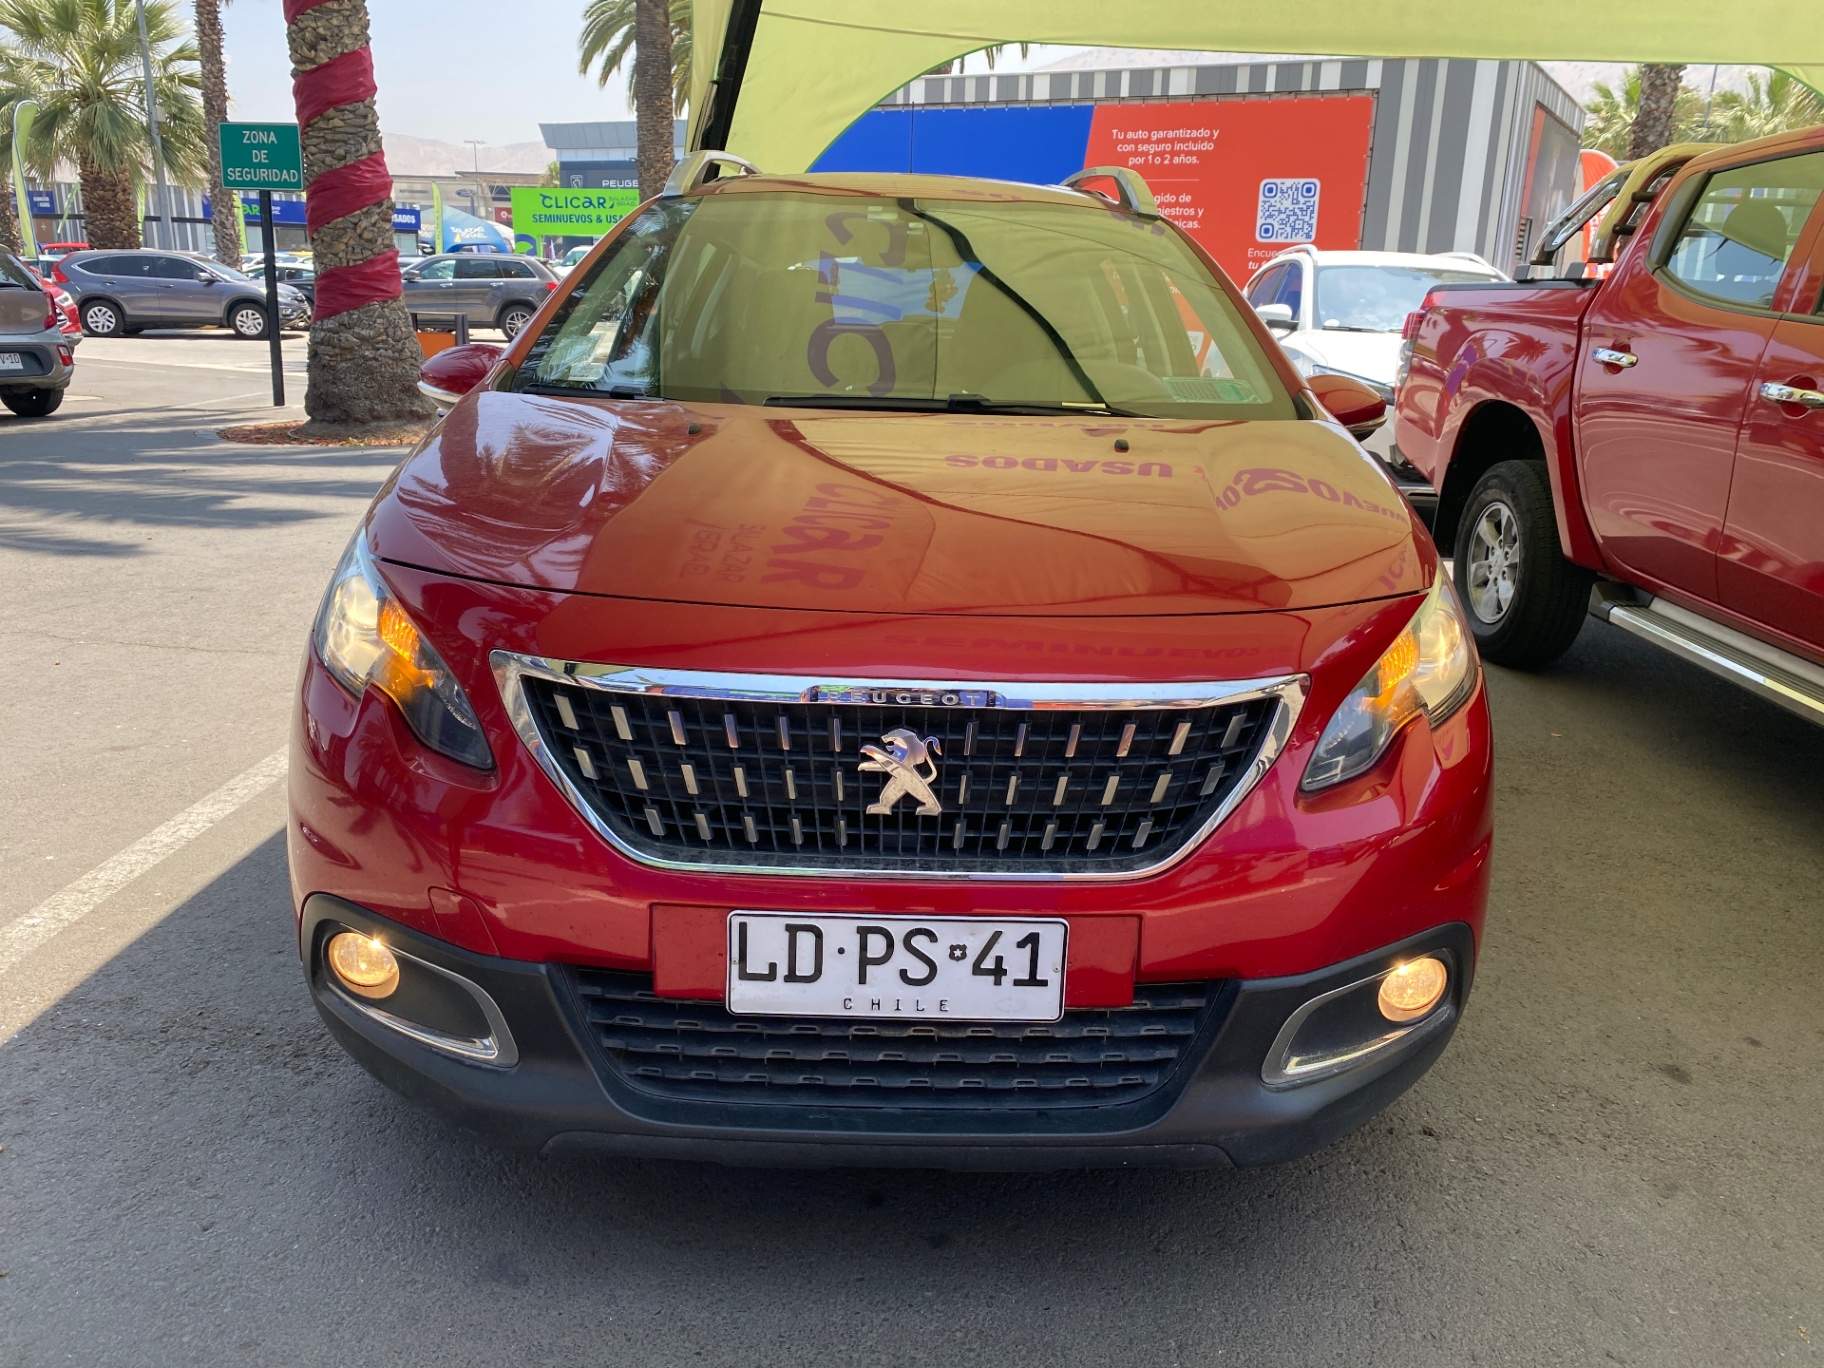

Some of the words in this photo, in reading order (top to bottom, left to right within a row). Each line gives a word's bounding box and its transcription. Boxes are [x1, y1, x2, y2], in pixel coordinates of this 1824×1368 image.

[242, 130, 278, 144] ZONA
[1111, 129, 1124, 139] Tu
[1126, 130, 1149, 139] auto
[1151, 128, 1210, 141] garantizado
[1213, 129, 1220, 139] y
[1117, 144, 1135, 152] con
[1137, 143, 1172, 153] seguro
[1174, 141, 1215, 151] incluido
[252, 149, 269, 163] DE
[1128, 156, 1146, 168] por
[1163, 154, 1171, 164] 2
[1173, 153, 1200, 164] años.
[227, 167, 298, 182] SEGURIDAD
[602, 179, 639, 187] PEUGE
[1154, 193, 1176, 205] gido
[1178, 193, 1192, 203] de
[532, 214, 593, 223] SEMINUEVOS
[1197, 208, 1204, 218] y
[1248, 260, 1258, 270] tu
[827, 690, 981, 706] PEUGEOT
[843, 998, 949, 1012] CHILE
